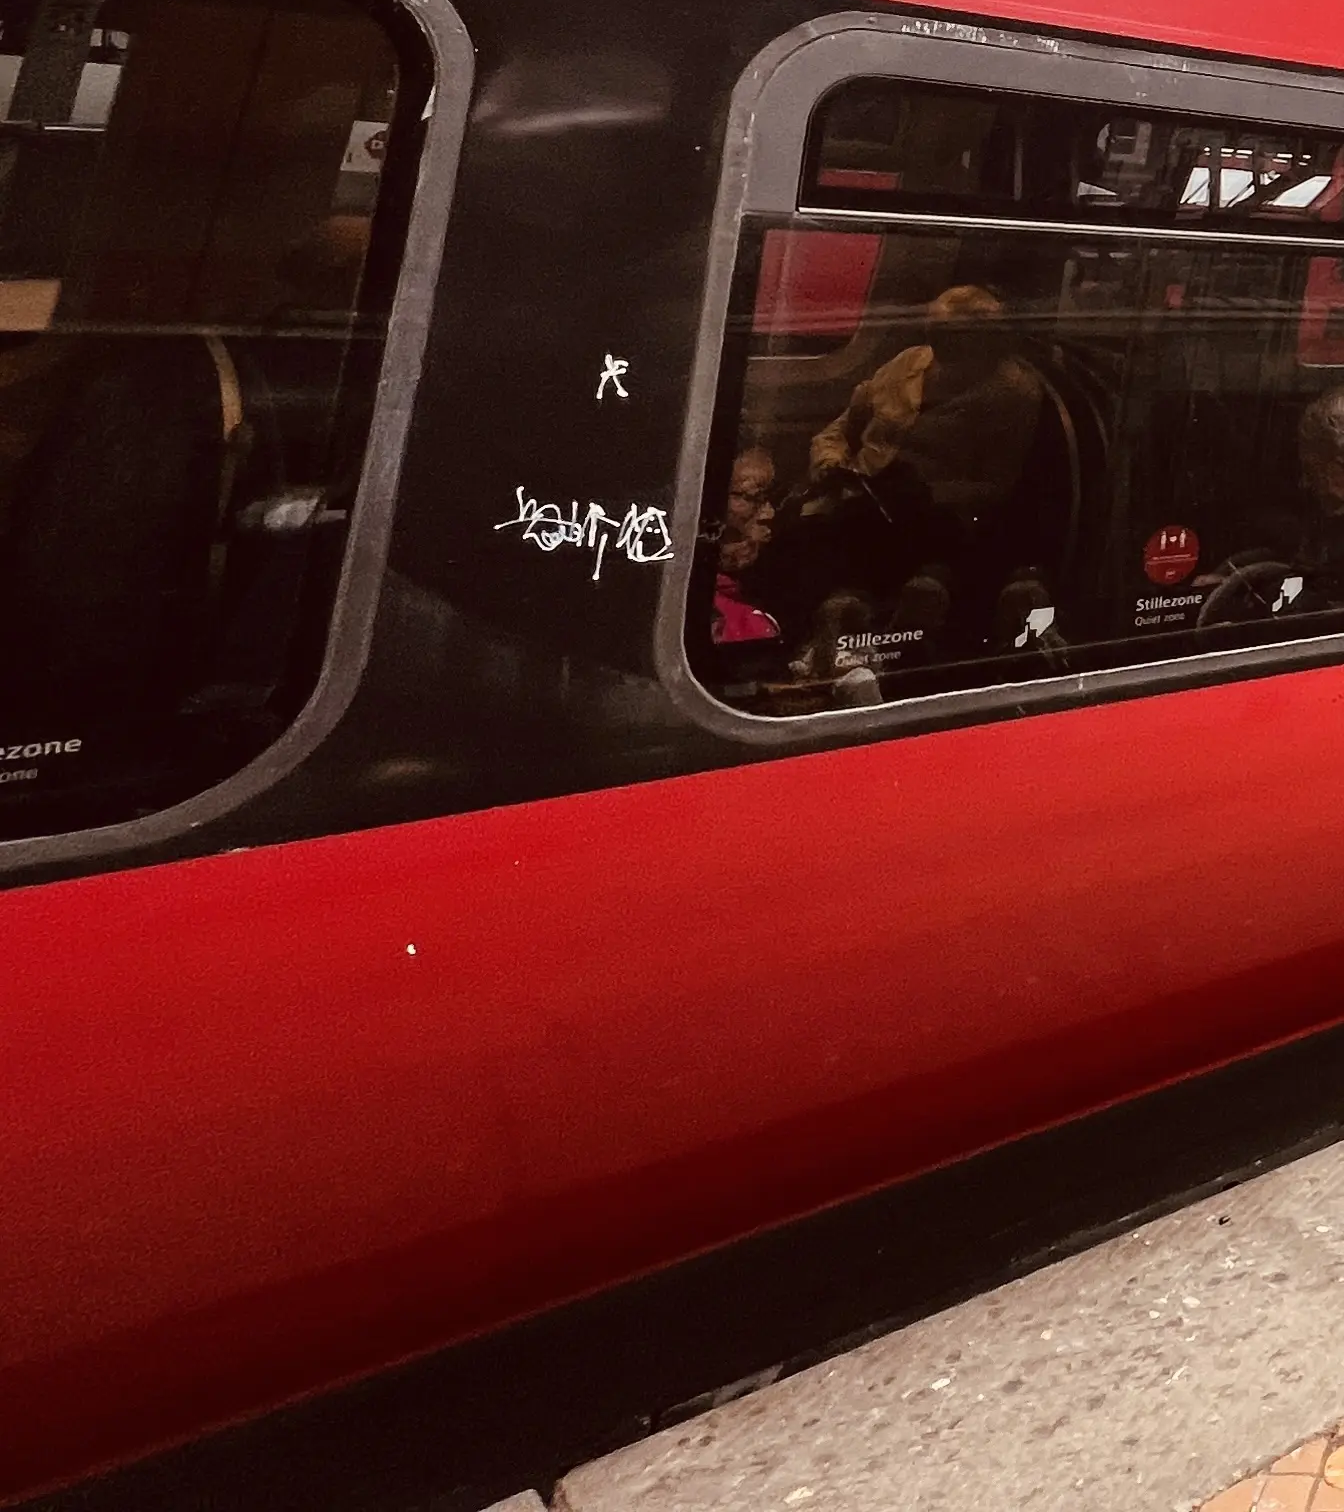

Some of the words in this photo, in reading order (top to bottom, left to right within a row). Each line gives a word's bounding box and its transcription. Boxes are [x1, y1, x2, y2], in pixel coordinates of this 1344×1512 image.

[1135, 594, 1203, 612] Stillezone
[836, 629, 924, 651] Stillezone
[872, 650, 902, 663] zone
